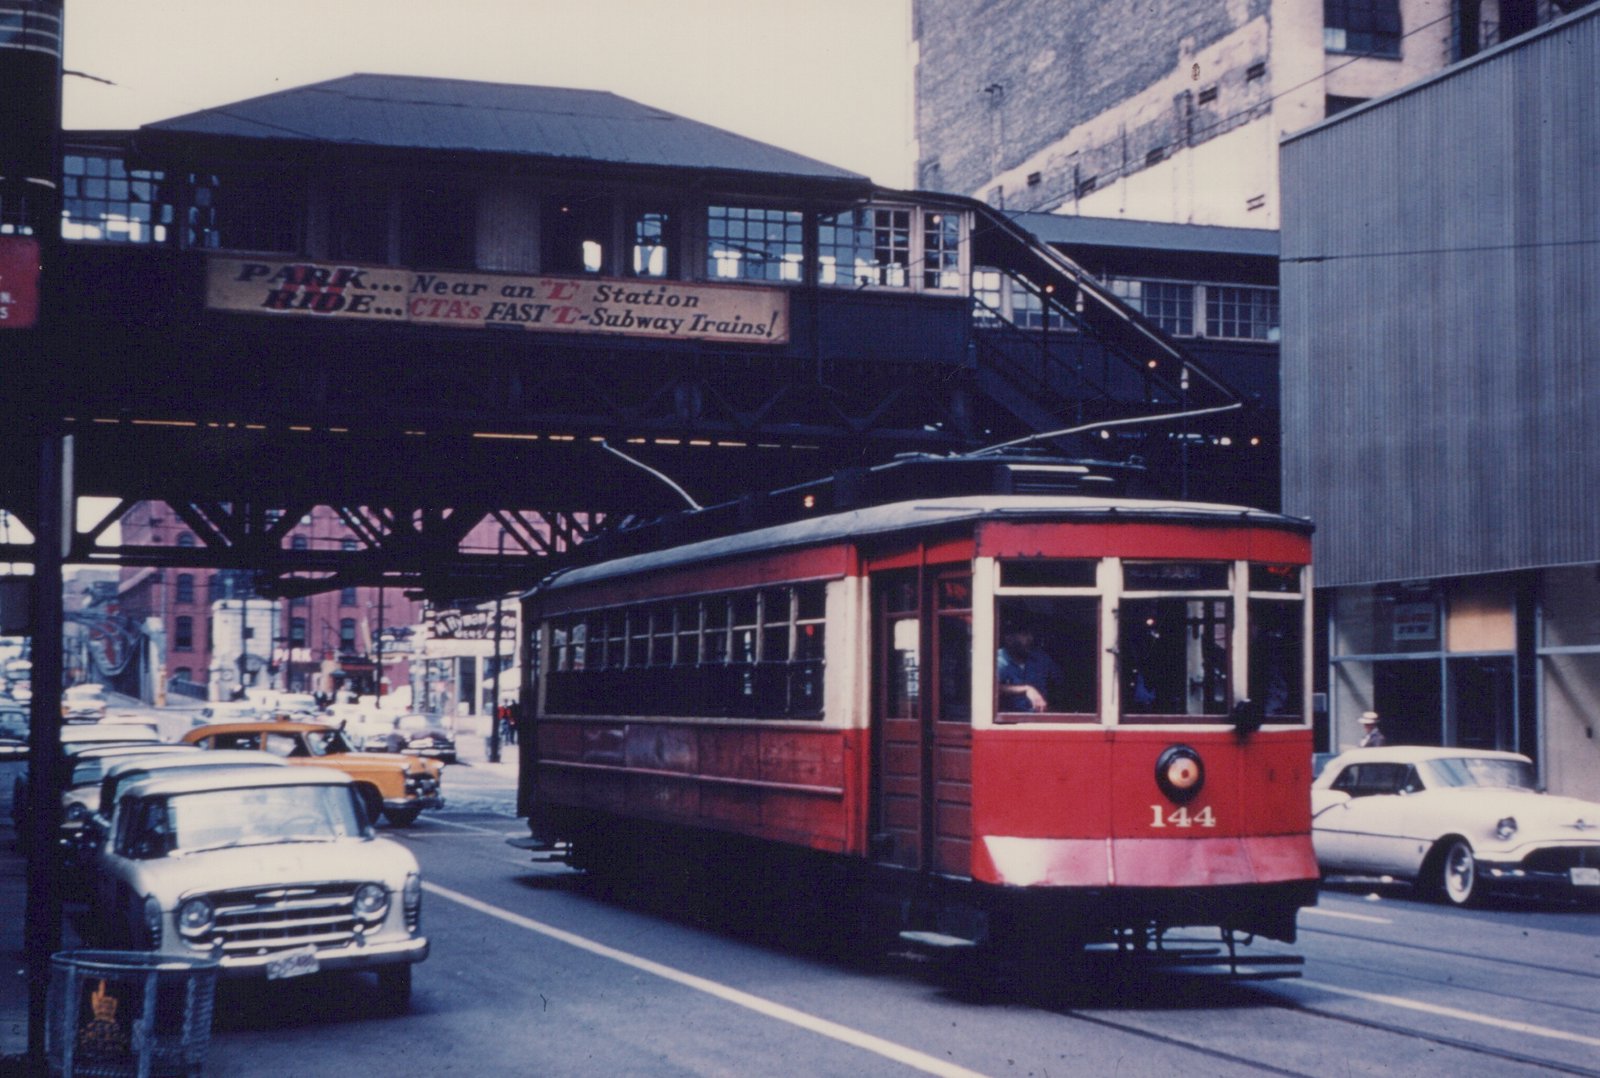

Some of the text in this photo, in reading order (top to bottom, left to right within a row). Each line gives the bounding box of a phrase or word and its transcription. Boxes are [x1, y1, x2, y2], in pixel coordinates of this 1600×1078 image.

[410, 275, 487, 297] Near
[501, 283, 535, 299] an
[593, 284, 699, 308] Station
[410, 298, 482, 320] CTA's
[484, 302, 551, 323] FAST
[689, 310, 779, 338] Trains!
[1150, 804, 1217, 828] 144
